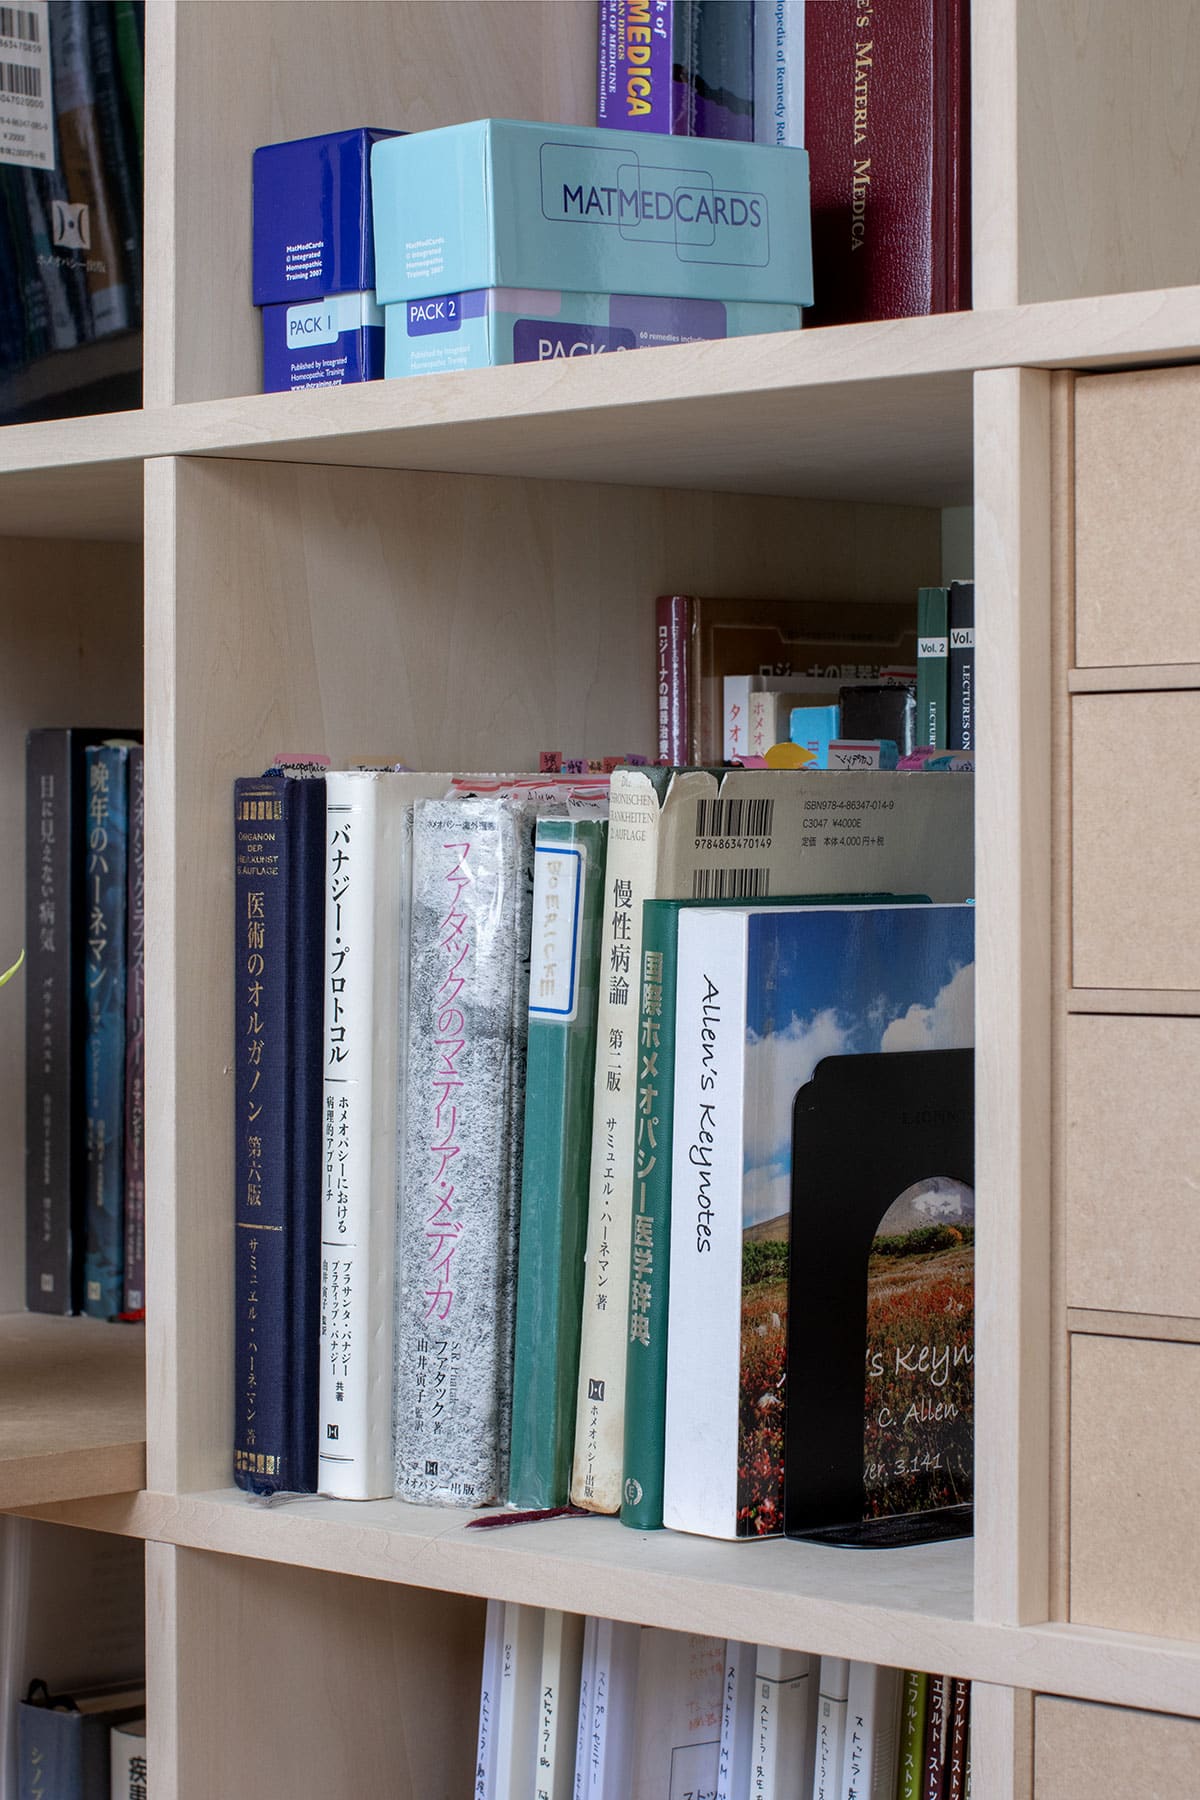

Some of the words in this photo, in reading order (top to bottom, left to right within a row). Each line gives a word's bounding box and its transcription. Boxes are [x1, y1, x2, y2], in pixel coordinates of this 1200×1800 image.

[609, 15, 617, 32] OF
[654, 17, 667, 39] of
[609, 33, 617, 94] MEDICINE
[776, 50, 786, 62] of
[775, 67, 786, 118] Remedy
[776, 122, 786, 146] Rel
[563, 184, 762, 228] MATMEDCARDS
[286, 241, 324, 253] MatMedCards
[292, 251, 321, 262] Integrated
[286, 261, 323, 272] Homeopathic
[286, 272, 309, 281] Training
[410, 302, 445, 322] PACK
[448, 300, 456, 317] 2
[290, 316, 322, 336] PACK
[639, 331, 648, 340] 60
[649, 333, 680, 342] remedies
[291, 362, 315, 371] Published
[322, 357, 348, 367] Integrated
[291, 371, 325, 382] Homeopathic
[325, 368, 345, 378] Training
[921, 644, 937, 653] Vol.
[939, 643, 945, 653] 2
[952, 632, 972, 644] Vol.
[962, 665, 970, 730] LECTURES
[962, 732, 970, 751] ON
[803, 818, 828, 828] C3047
[695, 838, 772, 850] 9784863470149
[801, 836, 817, 847] 定価
[39, 775, 56, 952] 目に見えない病気
[90, 763, 109, 988] 晩年のハーネマン
[328, 825, 351, 1065] バナジー・プロトコル
[609, 879, 633, 1006] 慢性病論
[247, 892, 265, 1122] 医術のオルガノン
[701, 974, 721, 1091] Allen's
[606, 1028, 623, 1092] 第二版
[630, 951, 663, 1347] 国際ホメオパシー医学辞典
[247, 1136, 262, 1207] 第六版
[337, 1096, 349, 1234] ホメオパシーにおける
[688, 1103, 716, 1254] Keynotes
[598, 1117, 617, 1288] サミュエル・ハーネマン
[596, 1293, 608, 1311] 著
[415, 1338, 428, 1404] 由井寅子
[895, 1344, 974, 1387] Keyn
[431, 1341, 448, 1418] ファタック
[336, 1381, 344, 1402] 共著
[902, 1398, 959, 1425] Allen
[893, 1453, 943, 1476] 3.141
